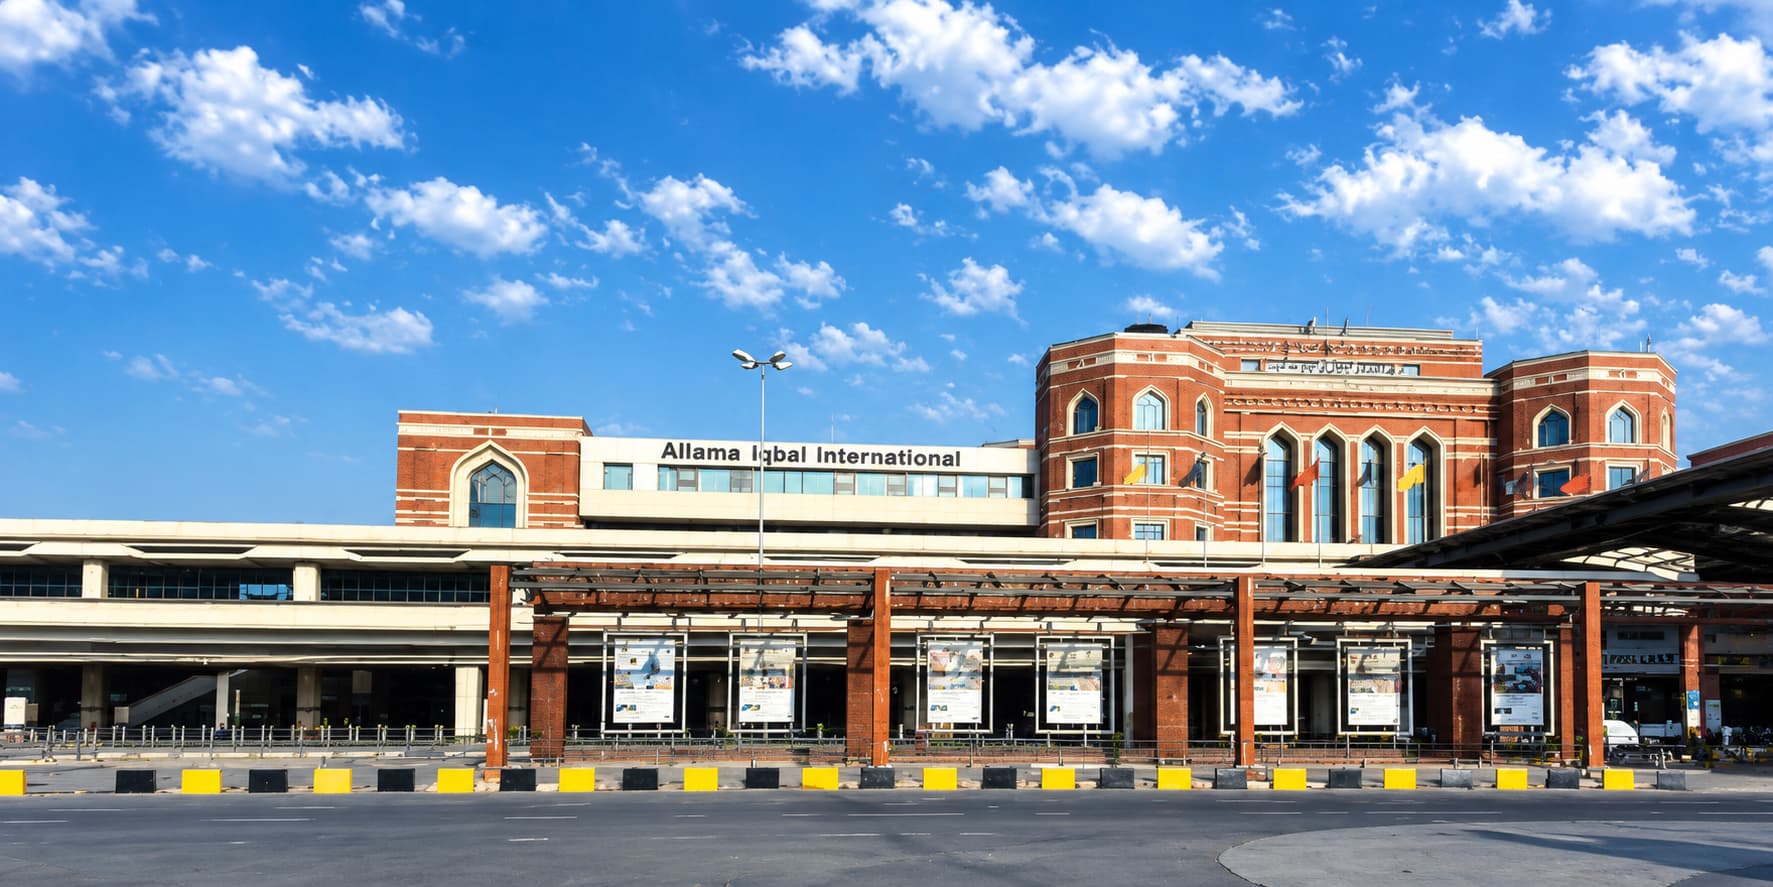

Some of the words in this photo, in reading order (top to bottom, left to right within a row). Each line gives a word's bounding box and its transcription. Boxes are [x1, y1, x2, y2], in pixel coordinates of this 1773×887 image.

[661, 442, 740, 461] Allama
[752, 445, 806, 465] Iqbal
[817, 446, 961, 467] International
